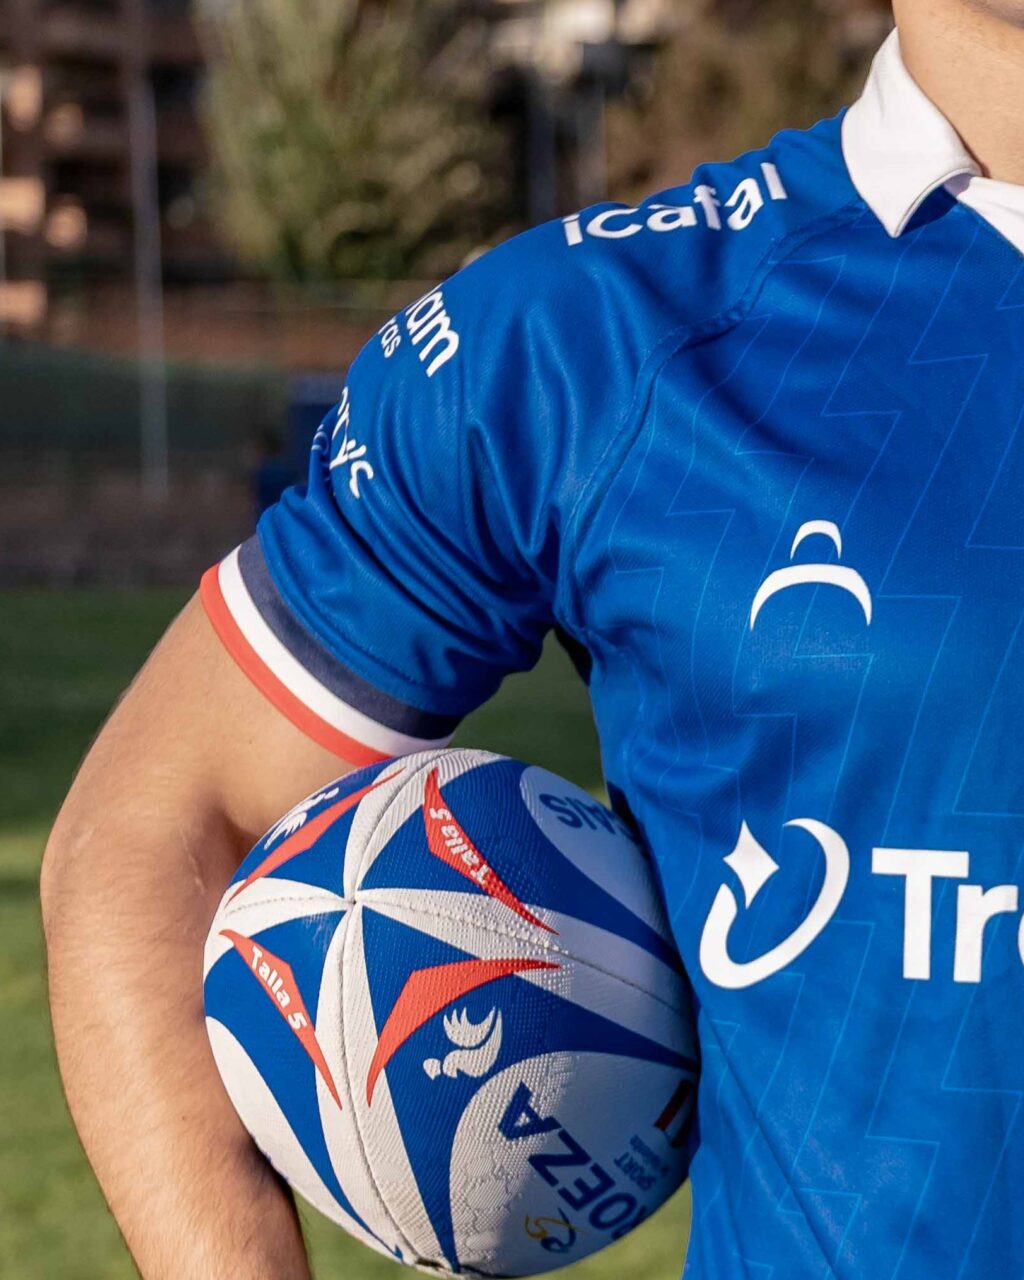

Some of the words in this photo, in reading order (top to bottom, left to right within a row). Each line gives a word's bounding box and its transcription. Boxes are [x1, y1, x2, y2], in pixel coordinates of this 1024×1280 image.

[560, 162, 788, 246] icafal
[429, 806, 452, 822] 5
[440, 824, 489, 885] Talla
[250, 945, 291, 1008] Talla
[287, 1009, 308, 1030] 5
